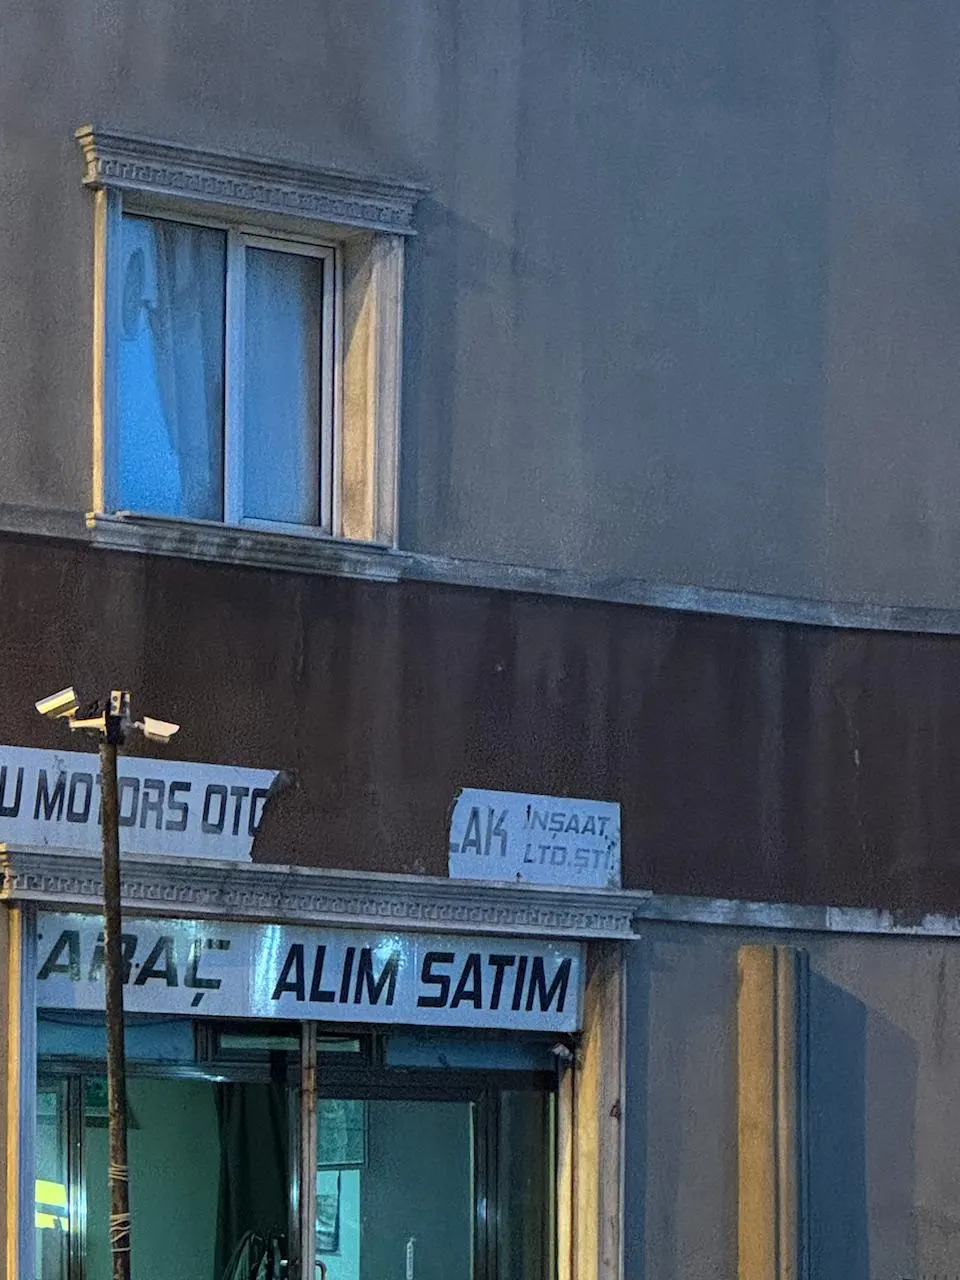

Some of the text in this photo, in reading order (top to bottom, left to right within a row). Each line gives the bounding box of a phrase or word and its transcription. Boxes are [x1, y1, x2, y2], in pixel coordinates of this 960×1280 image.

[34, 768, 192, 833] MOORS
[450, 806, 509, 857] AK
[271, 943, 401, 1007] ALIM
[416, 951, 573, 1014] SATIM
